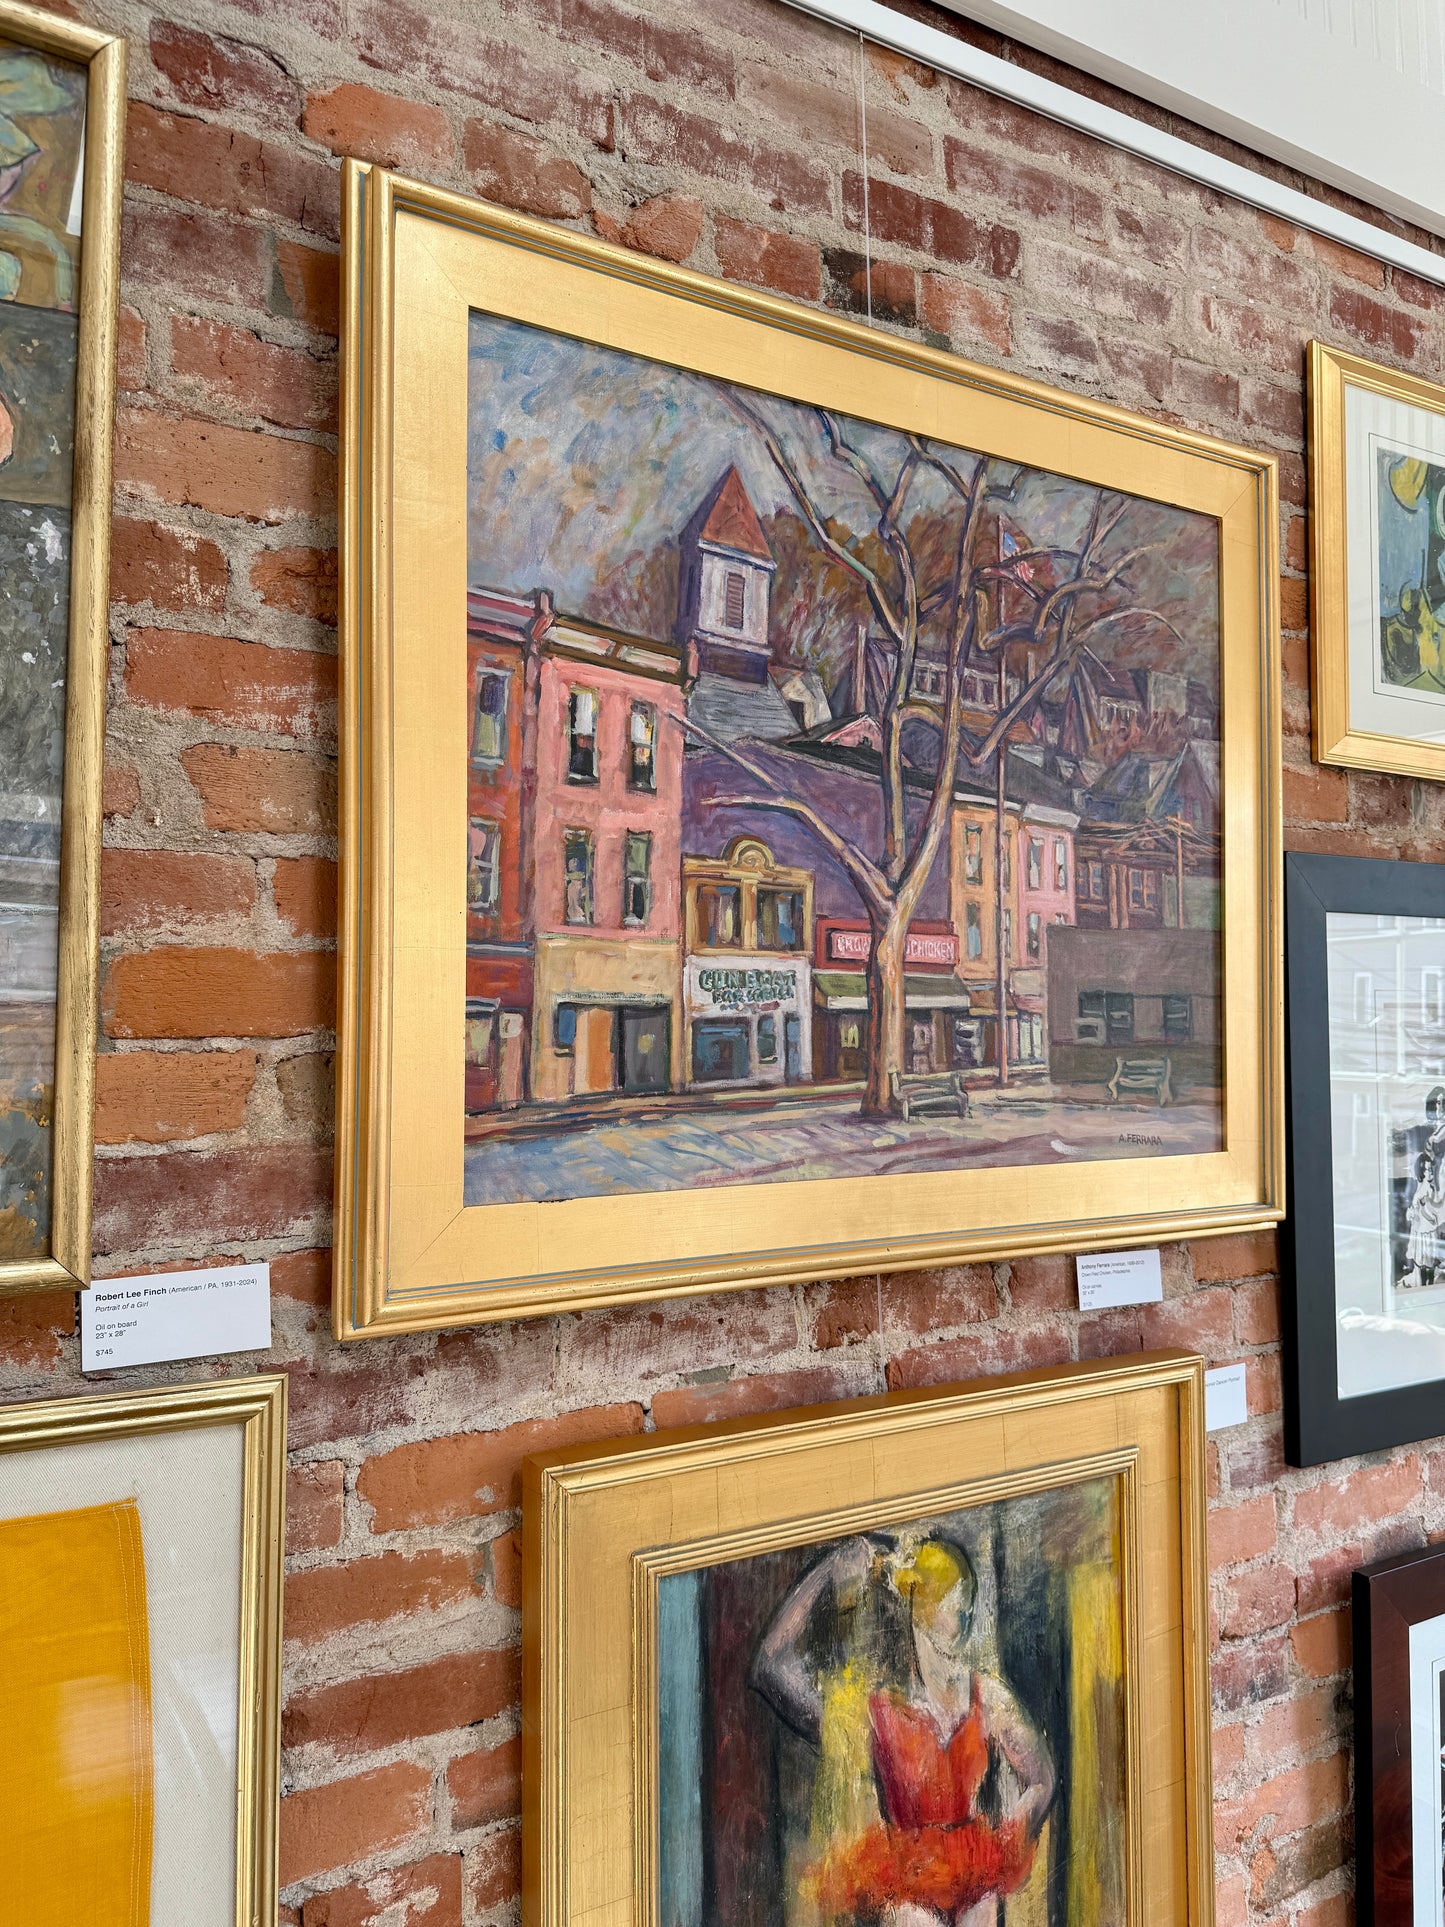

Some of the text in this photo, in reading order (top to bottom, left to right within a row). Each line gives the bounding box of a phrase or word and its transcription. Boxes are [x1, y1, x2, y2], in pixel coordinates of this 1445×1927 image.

[911, 939, 955, 960] CHICKEN
[699, 968, 797, 991] GUN BOAT
[95, 1292, 124, 1302] Robert
[126, 1290, 142, 1298] Lee
[143, 1287, 167, 1296] Finch
[168, 1284, 203, 1295] (American
[221, 1278, 258, 1288] 1931-2024)
[95, 1304, 121, 1312] Portrait
[95, 1323, 105, 1331] Oil
[117, 1320, 137, 1328] board
[95, 1331, 107, 1339] 23"
[95, 1348, 113, 1356] $745
